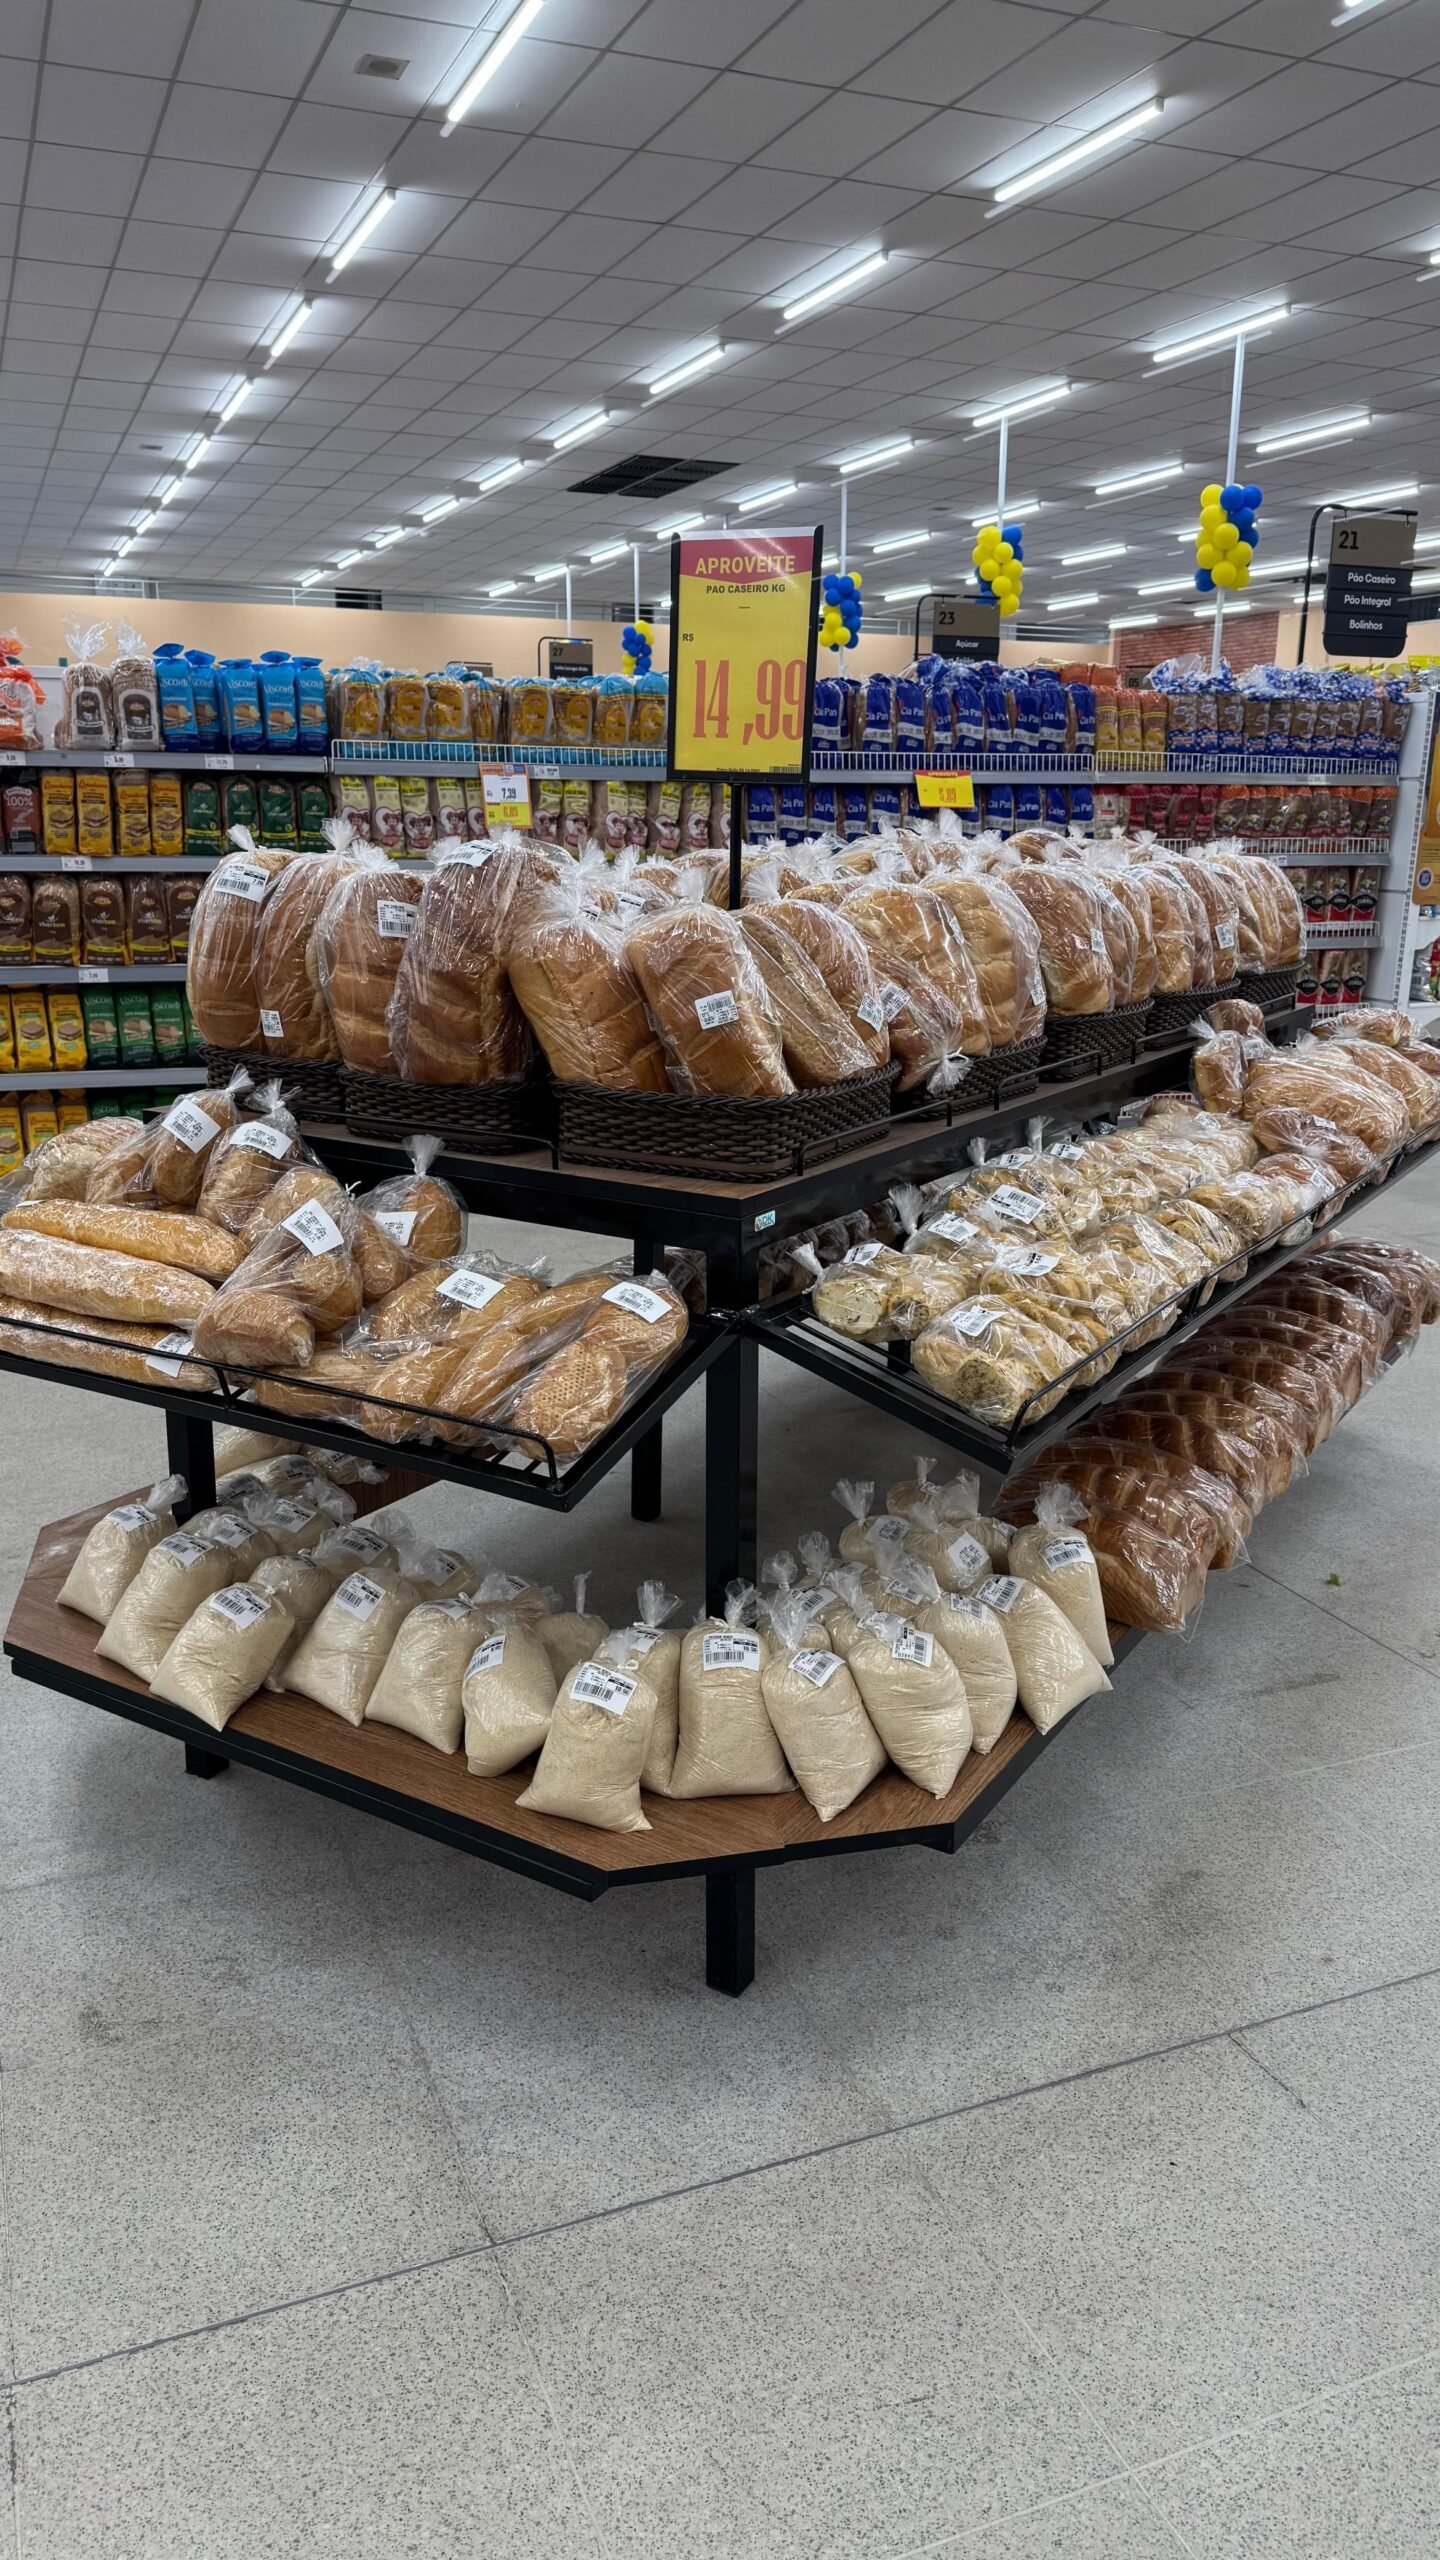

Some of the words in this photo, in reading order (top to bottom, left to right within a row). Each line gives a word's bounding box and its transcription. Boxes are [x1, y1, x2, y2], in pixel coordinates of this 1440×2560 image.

[1338, 530, 1359, 550] 21
[695, 555, 796, 575] APROVEITE
[1348, 572, 1363, 582] Pão
[1365, 573, 1396, 585] Caseiro
[706, 584, 725, 594] PAO
[728, 584, 770, 594] CASEIRO
[772, 583, 786, 593] KG
[1344, 594, 1360, 605] Pão
[1361, 595, 1392, 608] Integral
[938, 611, 955, 625] 23
[1349, 619, 1383, 631] Bolinhos
[682, 632, 694, 643] R$
[552, 647, 563, 657] 27
[6, 796, 33, 806] 100%
